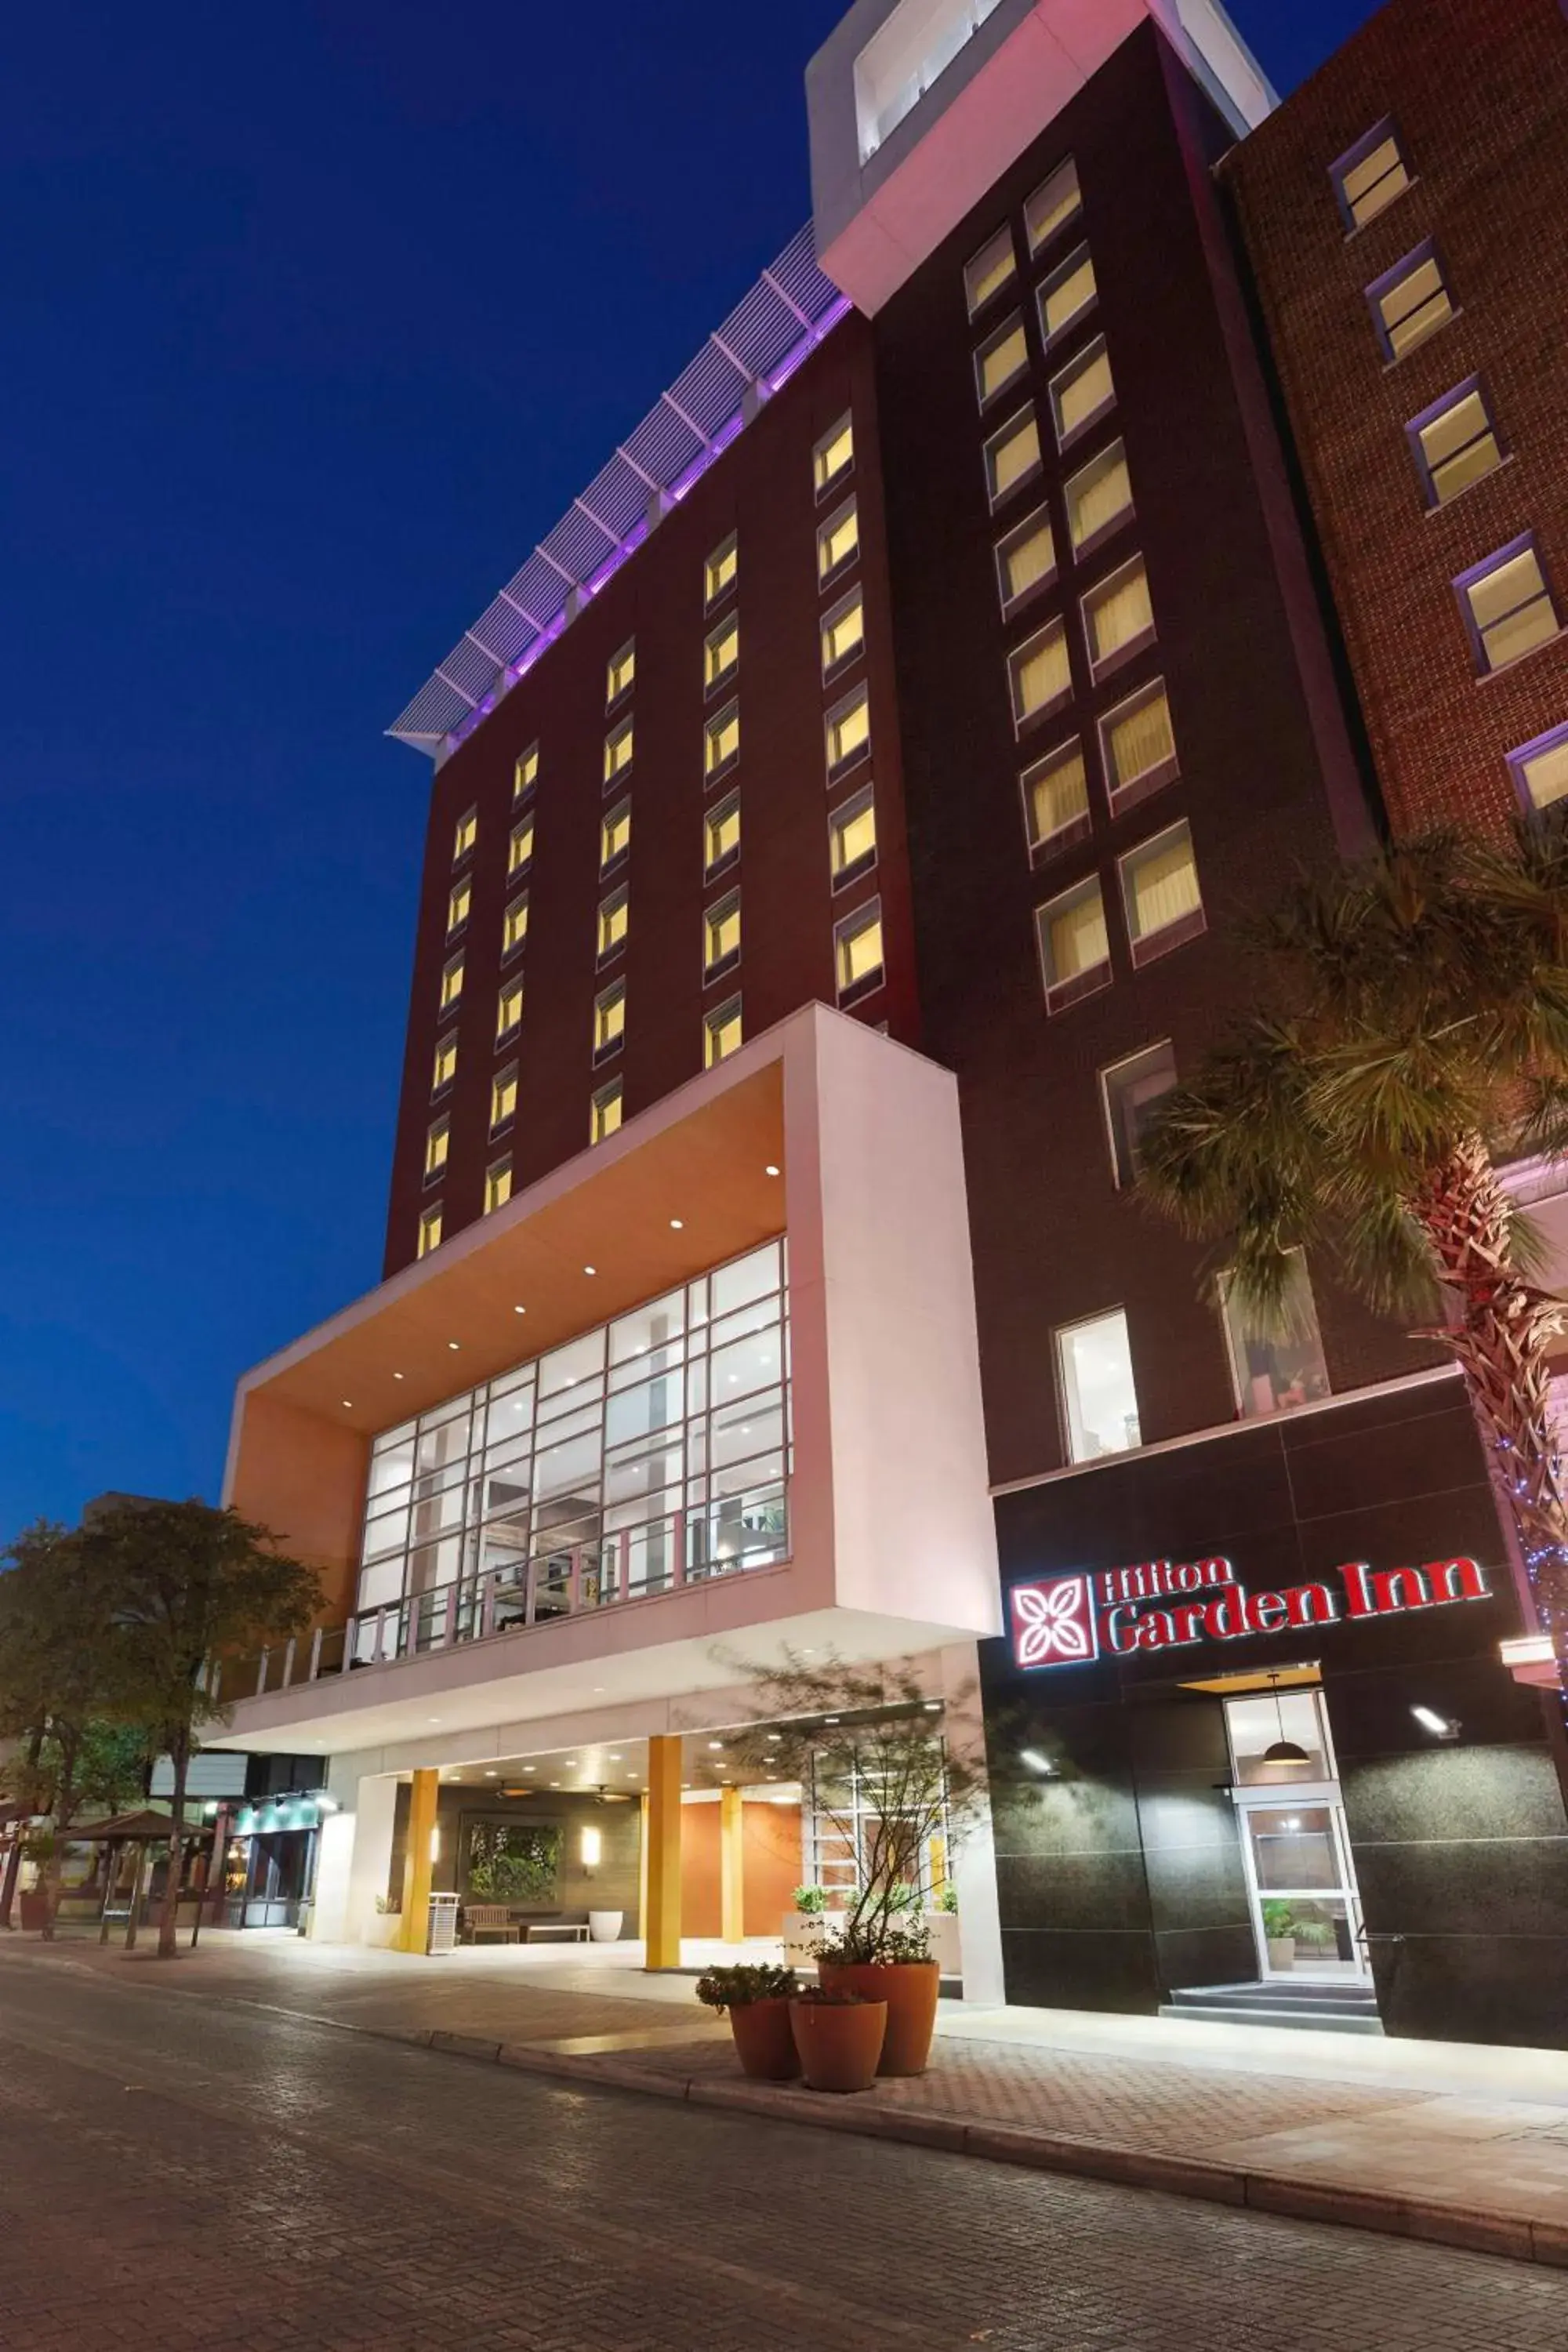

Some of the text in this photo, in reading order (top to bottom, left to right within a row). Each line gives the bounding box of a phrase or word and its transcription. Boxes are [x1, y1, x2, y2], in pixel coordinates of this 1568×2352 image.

[1096, 1556, 1236, 1607] Hilton
[1098, 1556, 1493, 1655] Garden Inn
